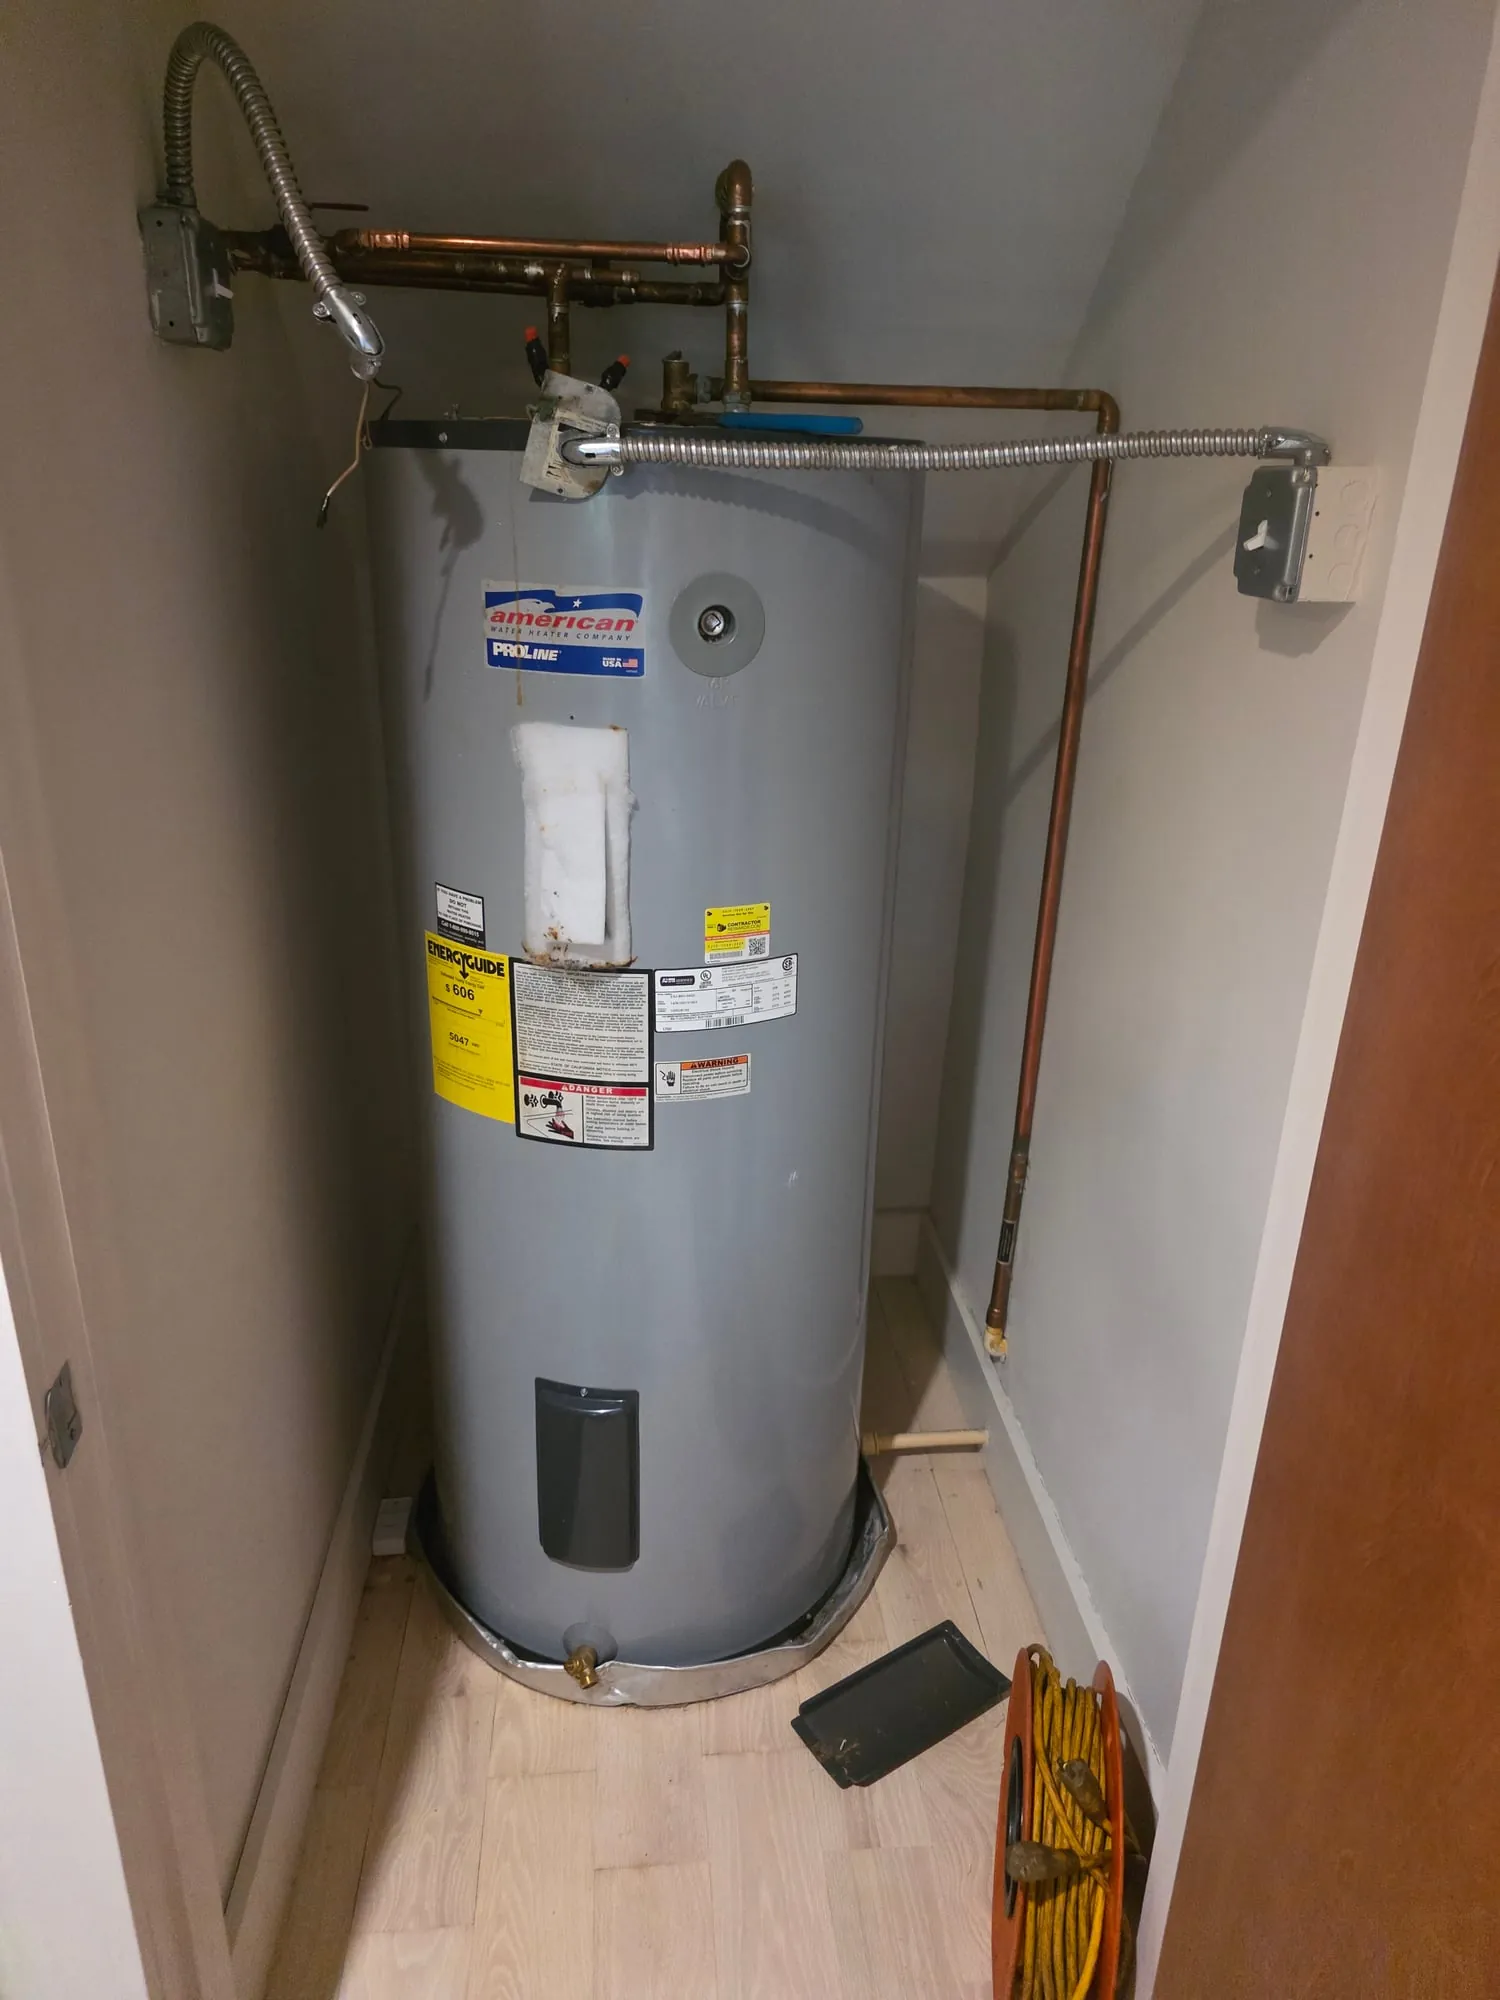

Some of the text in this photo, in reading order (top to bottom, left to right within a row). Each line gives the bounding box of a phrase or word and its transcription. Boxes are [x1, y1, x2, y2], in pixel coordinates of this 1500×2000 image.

[490, 611, 635, 632] american
[491, 626, 631, 641] WATER HEATER COMPANY
[492, 641, 558, 661] PROLINE
[602, 660, 622, 668] USA
[727, 919, 761, 927] CONTRACTOR
[428, 939, 505, 977] ENERGYGUIDE
[445, 983, 475, 1001] $ 606
[449, 1031, 470, 1047] 5047
[697, 1057, 739, 1068] WARNING
[569, 1084, 613, 1094] DANGER
